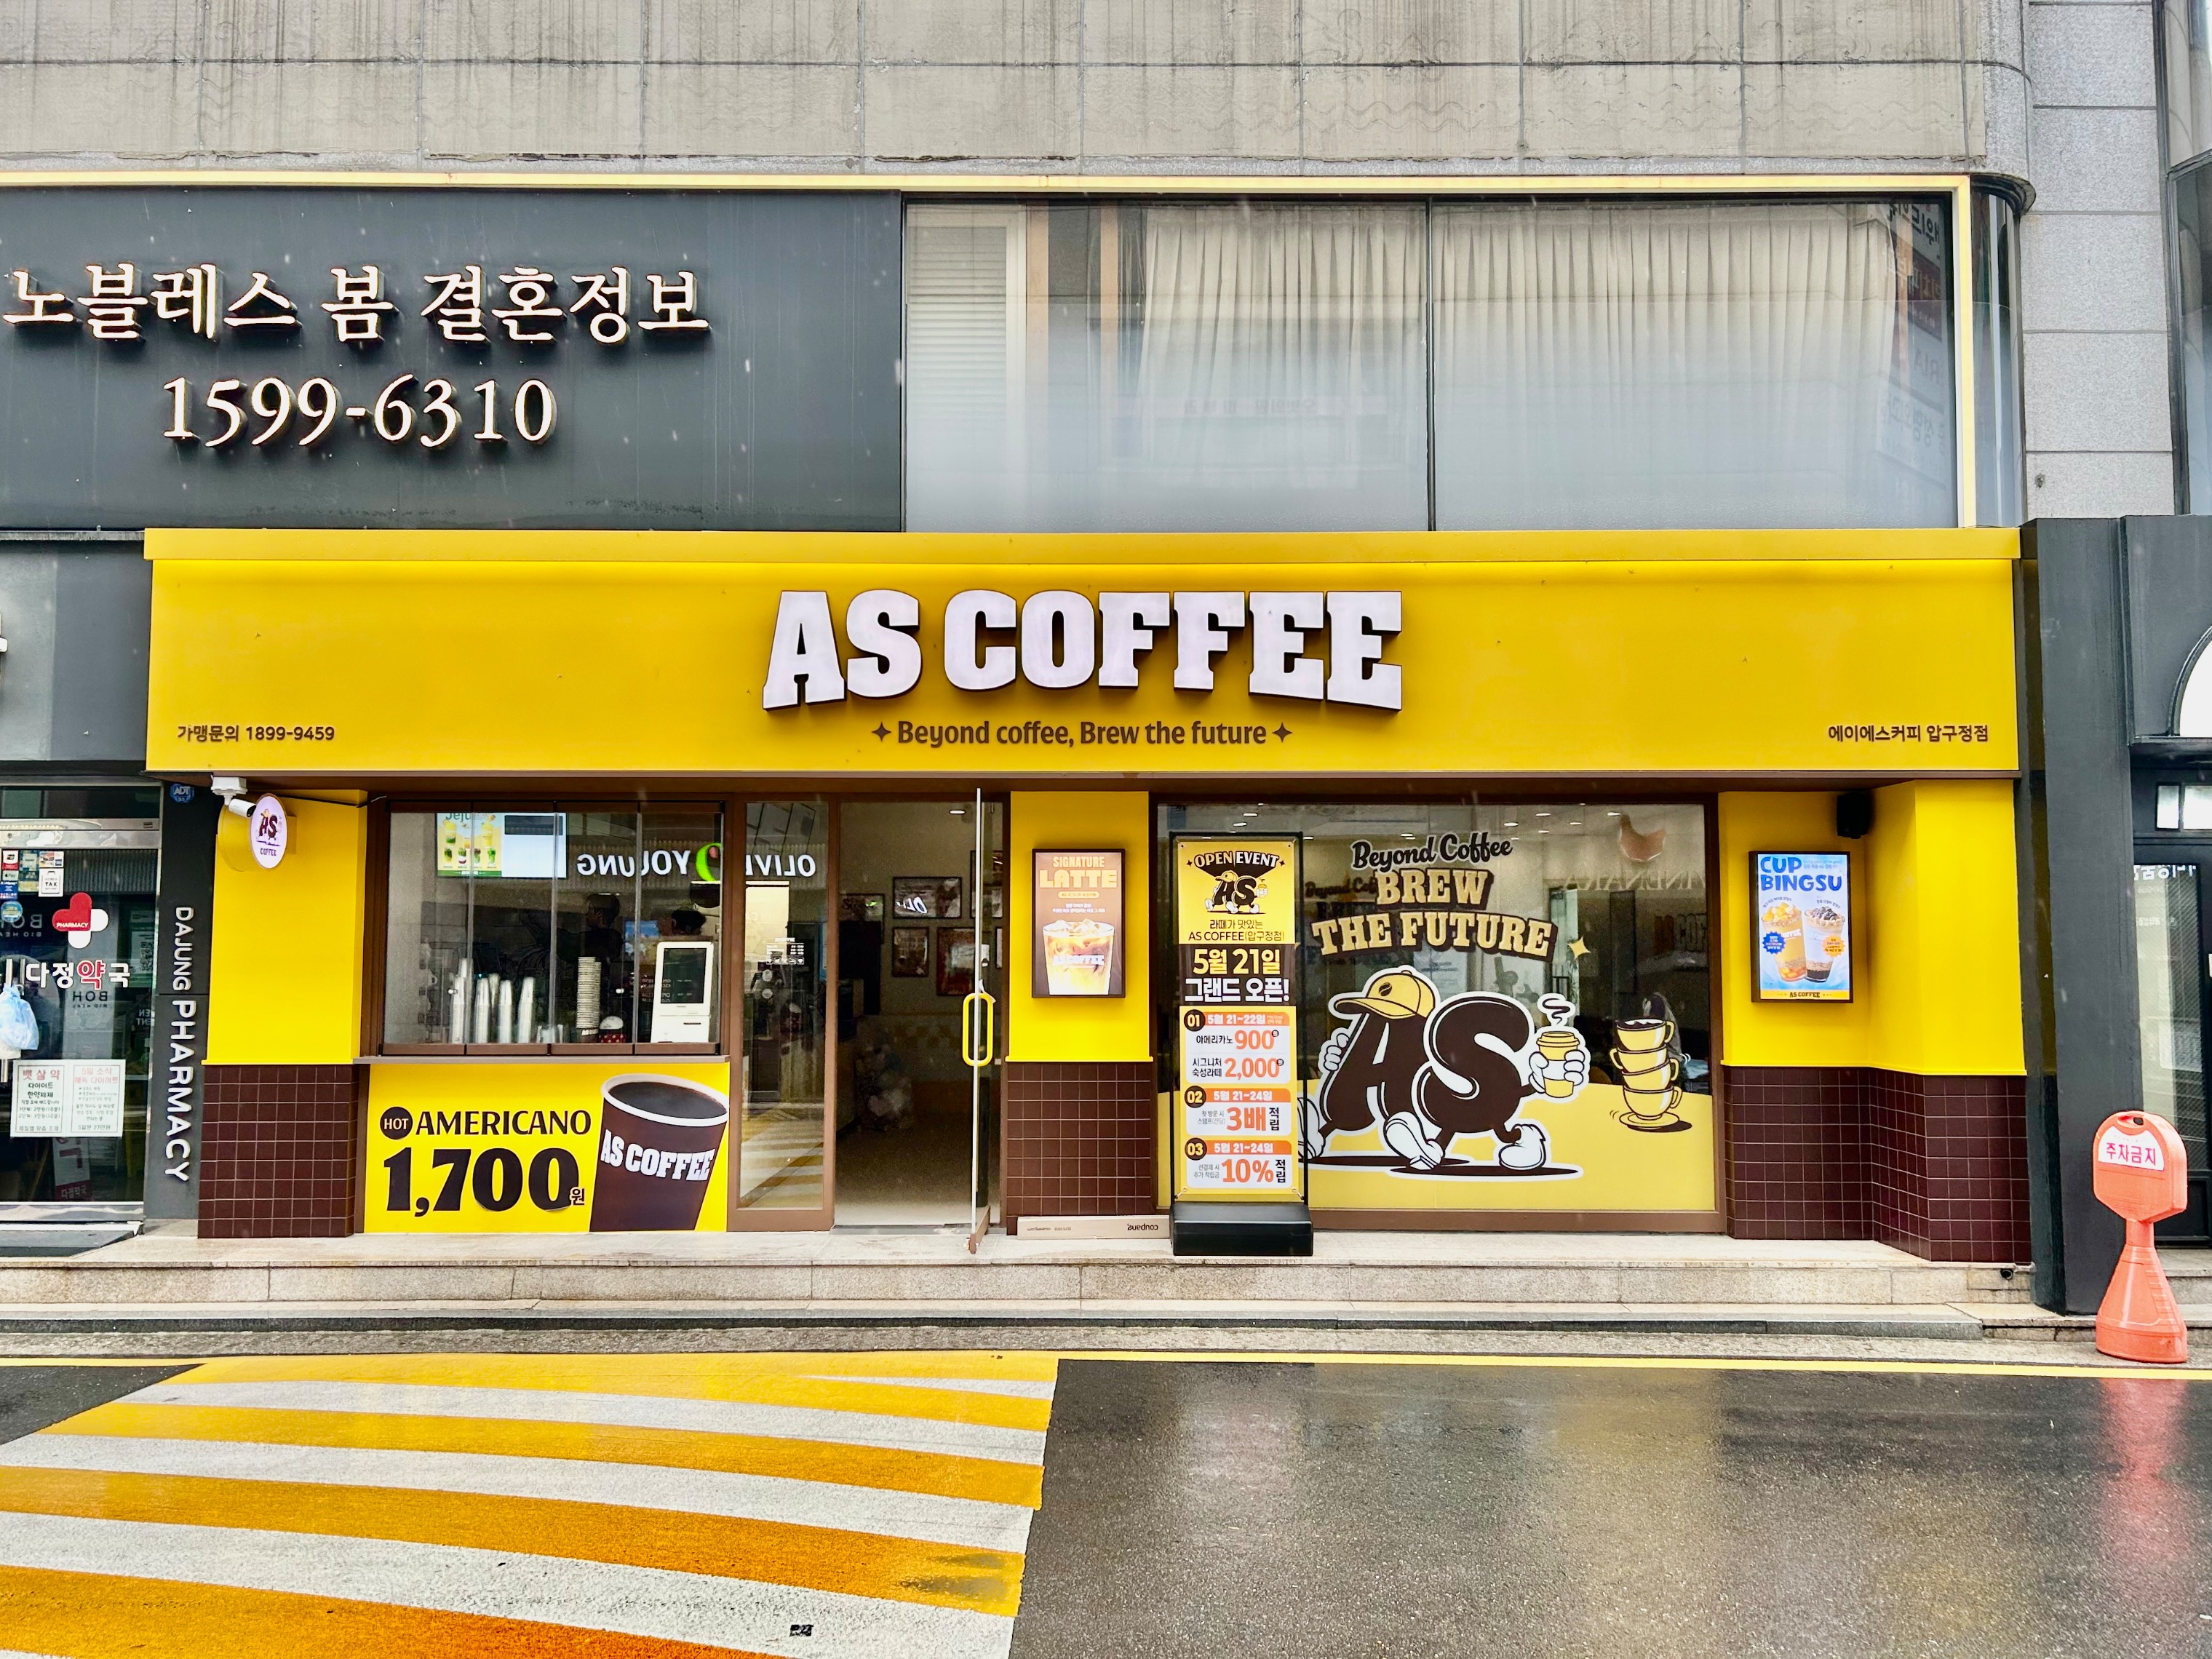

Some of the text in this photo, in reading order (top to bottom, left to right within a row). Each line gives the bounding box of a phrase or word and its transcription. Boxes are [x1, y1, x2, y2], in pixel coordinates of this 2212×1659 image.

[3, 263, 711, 345] 노블레스 봄 결혼정보
[164, 374, 557, 448] 1599-6310
[762, 589, 1404, 712] AS COFFEE
[178, 725, 335, 742] 가맹문의 1899-9459
[898, 720, 1266, 749] Beyond coffee, Brew the future
[1829, 725, 1989, 742] 에이에스커피 압구정점
[174, 786, 191, 795] ADT
[258, 815, 278, 839] AS
[1053, 856, 1105, 868] SIGNATURE
[1193, 851, 1279, 868] OPEN EVENT
[1352, 832, 1512, 872] Beyond Coffee
[1760, 856, 1802, 873] CUP
[1039, 870, 1118, 888] LATTE
[1374, 869, 1494, 910] BREW
[1760, 875, 1842, 891] BINGSU
[1213, 875, 1257, 907] AS
[1210, 920, 1263, 929] 라떼가 맛있는
[1189, 932, 1202, 941] AS
[1311, 910, 1558, 962] THE FUTURE
[1193, 948, 1281, 975] 5월 21일
[25, 959, 131, 990] 다정약국
[1185, 978, 1289, 1003] 그랜드 오픈!
[1187, 1014, 1201, 1027] 01
[1208, 1014, 1265, 1025] 5월 21~22일
[164, 907, 196, 1182] DAJUNG PHARMACY
[1196, 1035, 1233, 1044] 아메리카노
[1193, 1058, 1222, 1067] 시그니처
[1193, 1068, 1222, 1078] 숙성라떼
[1187, 1091, 1203, 1104] 02
[1214, 1091, 1273, 1101] 5월 21~24일
[383, 1110, 592, 1135] HOT AMERICANO
[1227, 1107, 1266, 1131] 3배
[1269, 1107, 1279, 1131] 적립
[601, 1129, 715, 1182] AS COFFEE
[1187, 1142, 1204, 1156] 03
[1214, 1143, 1273, 1153] 5월 21~24일
[2106, 1142, 2156, 1166] 주차금지
[1221, 1158, 1274, 1183] 10%
[1276, 1159, 1286, 1183] 적립
[1127, 1223, 1158, 1232] coupang
